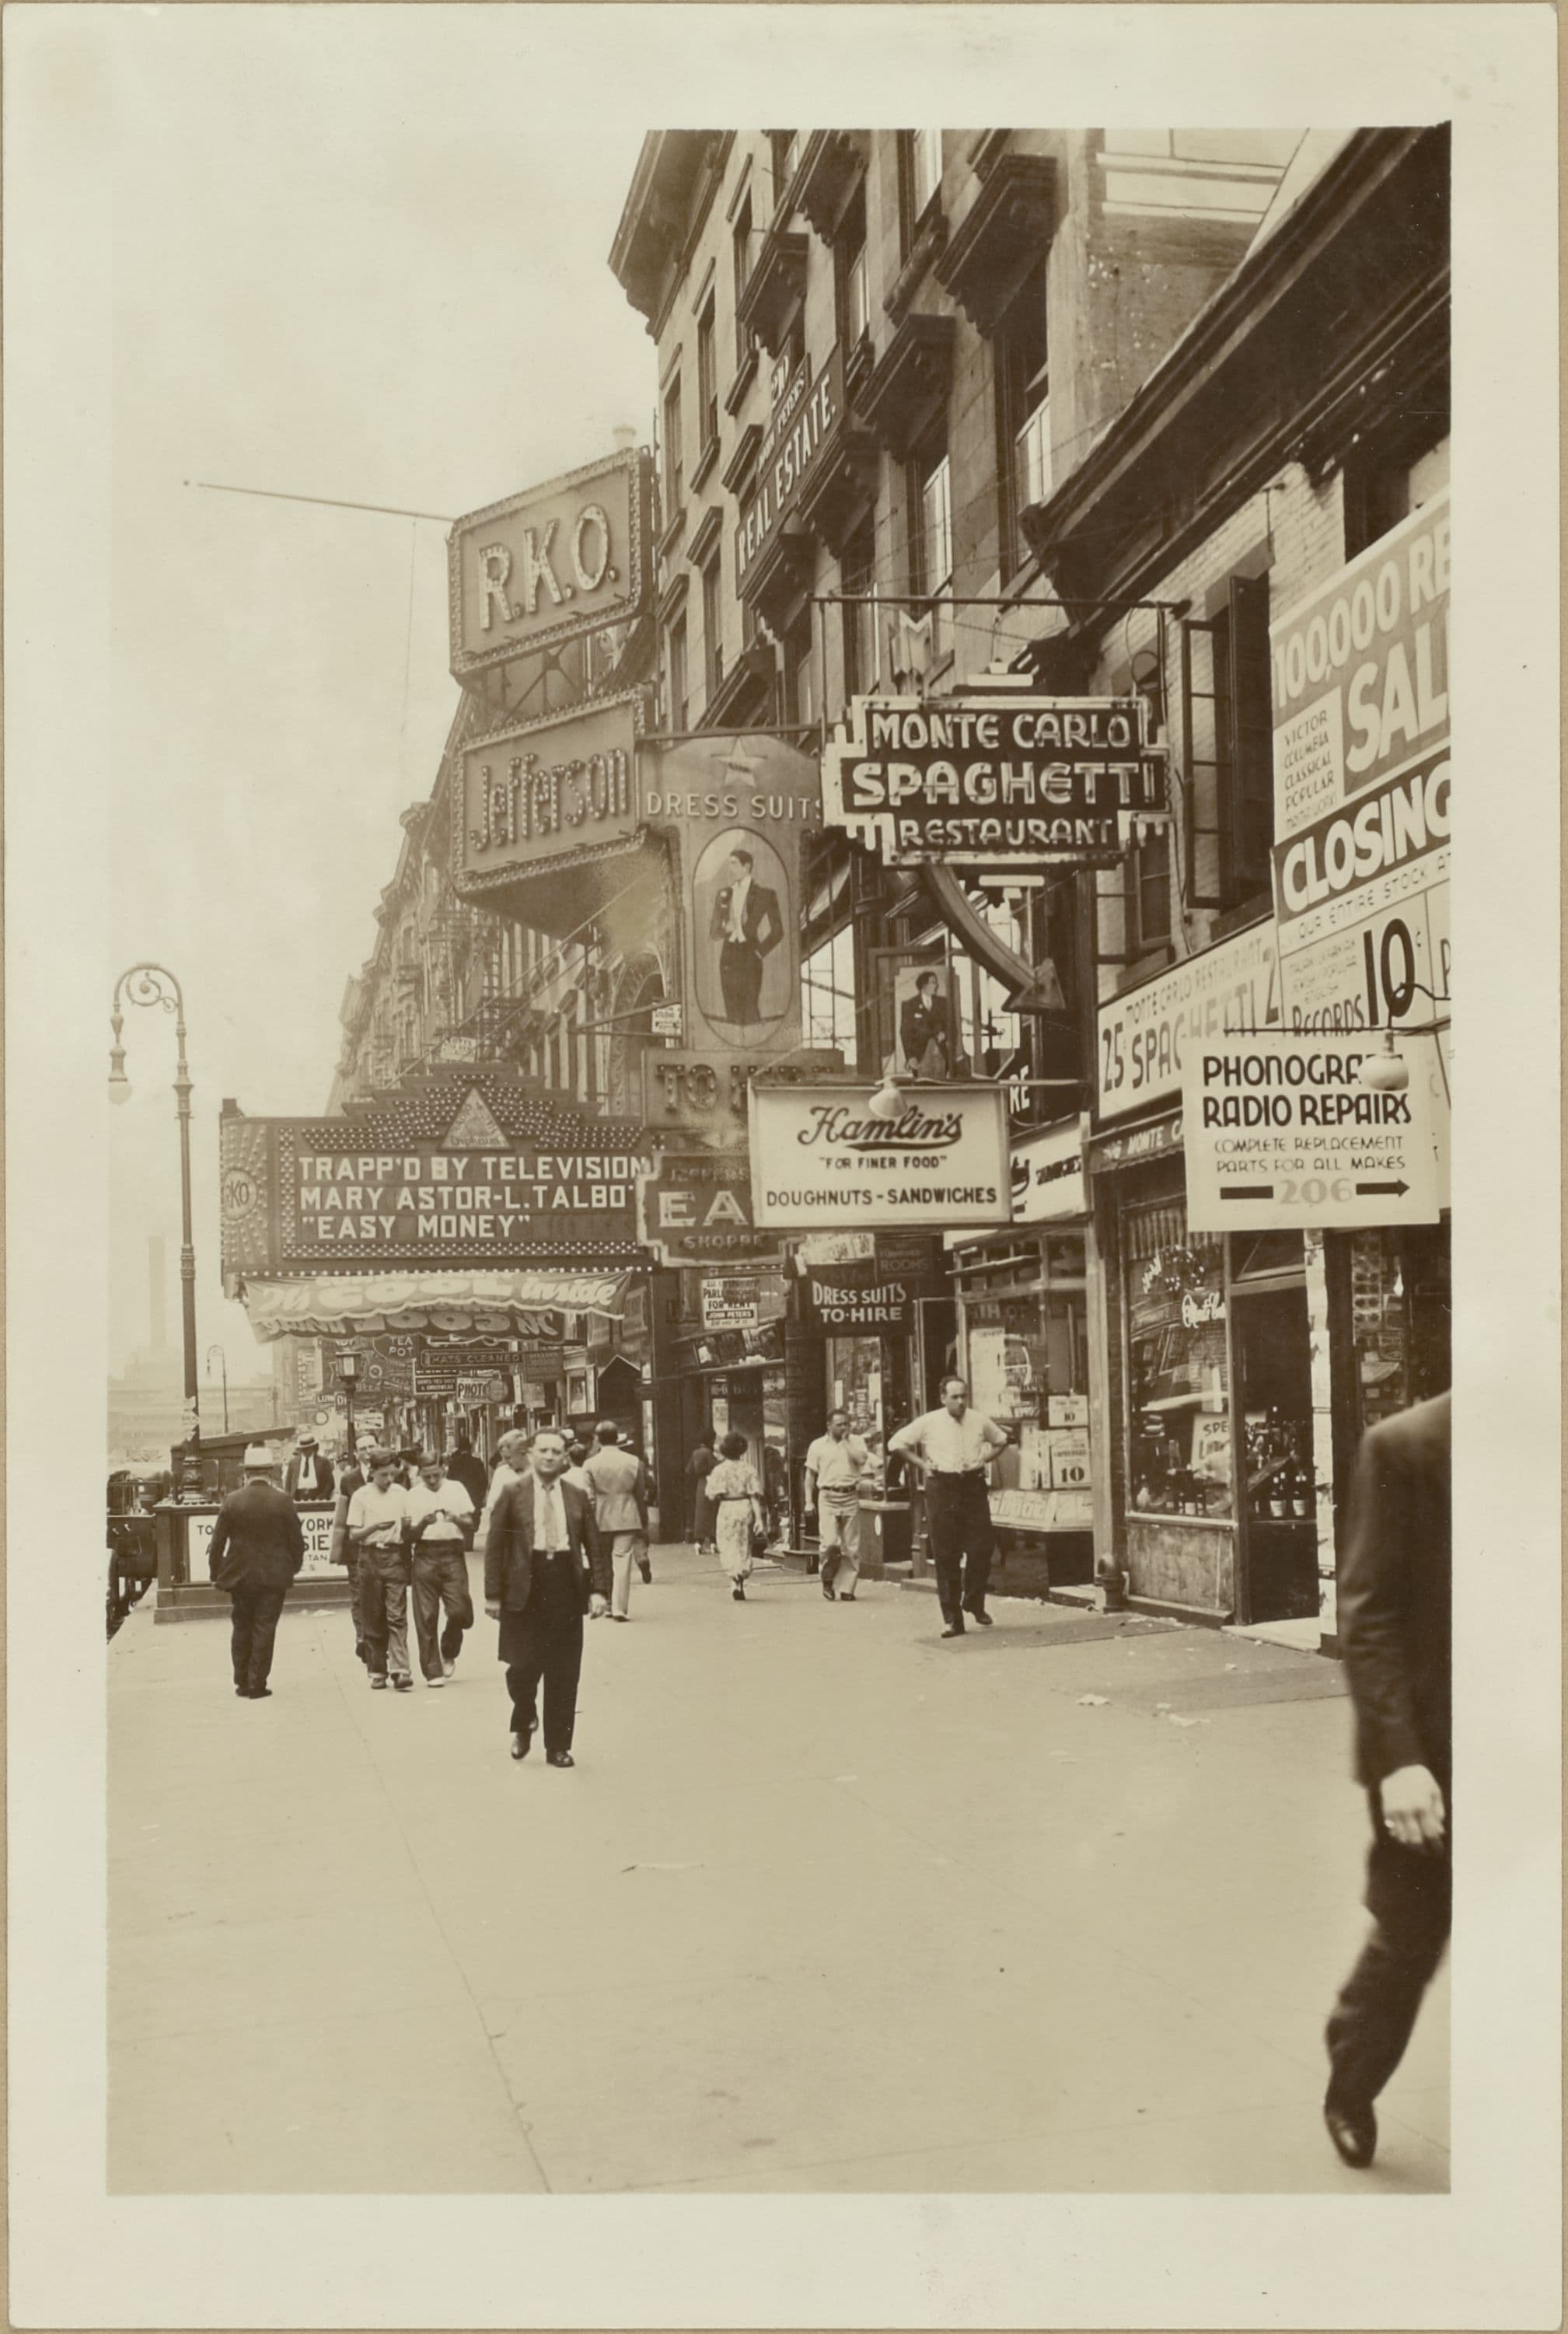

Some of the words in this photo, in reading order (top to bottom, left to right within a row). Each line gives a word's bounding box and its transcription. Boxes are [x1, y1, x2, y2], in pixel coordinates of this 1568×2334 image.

[739, 487, 772, 570] REAL
[775, 373, 836, 509] ESTATE.
[479, 504, 620, 631] R.K.O.
[1276, 560, 1400, 708] 100,000
[1409, 519, 1450, 613] RE
[1346, 622, 1450, 773] SAL
[872, 713, 1000, 749] MONTE
[1012, 713, 1130, 749] CARLO
[1285, 710, 1327, 746] VICTOR
[852, 760, 1155, 806] SPAGHETTI
[469, 747, 627, 852] Jefferson
[648, 792, 739, 821] DRESS
[899, 818, 1112, 847] RESTAURANT
[1283, 760, 1450, 912] CLOSING
[1384, 865, 1428, 899] STOCK
[1161, 974, 1192, 1012] CARLO
[1292, 994, 1364, 1037] RECORDS
[1203, 1054, 1403, 1087] PHONOGRA
[655, 1064, 716, 1112] TO
[1010, 1064, 1030, 1113] RE
[797, 1104, 963, 1145] Hamlin's
[1203, 1095, 1291, 1128] RADIO
[1301, 1092, 1412, 1127] REPAIRS
[1215, 1137, 1287, 1153] COMPLETE
[1295, 1136, 1403, 1151] REPLACEMENT
[299, 1157, 420, 1181] TRAPP'D
[431, 1157, 475, 1180] BY
[482, 1156, 647, 1181] TELEVISION
[857, 1155, 897, 1169] FINER
[1217, 1158, 1268, 1172] PARTS
[1275, 1157, 1304, 1172] FOR
[1314, 1157, 1342, 1171] ALL
[1351, 1155, 1406, 1171] MAKES
[301, 1186, 384, 1211] MARY
[397, 1185, 634, 1210] ASTOR-L.TALBO
[767, 1188, 871, 1207] DOUGHNUTS
[888, 1186, 997, 1204] SANDWICHES
[1279, 1178, 1352, 1205] 206
[659, 1190, 749, 1227] EA
[521, 1277, 617, 1306] inside
[812, 1281, 857, 1305] DRESS
[861, 1283, 906, 1305] SUITS
[389, 1347, 414, 1357] POT
[390, 1336, 413, 1347] TEA
[467, 1354, 520, 1363] CLEANED
[459, 1382, 487, 1398] PHOT
[1203, 1421, 1228, 1436] SPE
[1061, 1466, 1084, 1483] 10
[197, 1525, 214, 1536] TO
[303, 1535, 330, 1551] SIE
